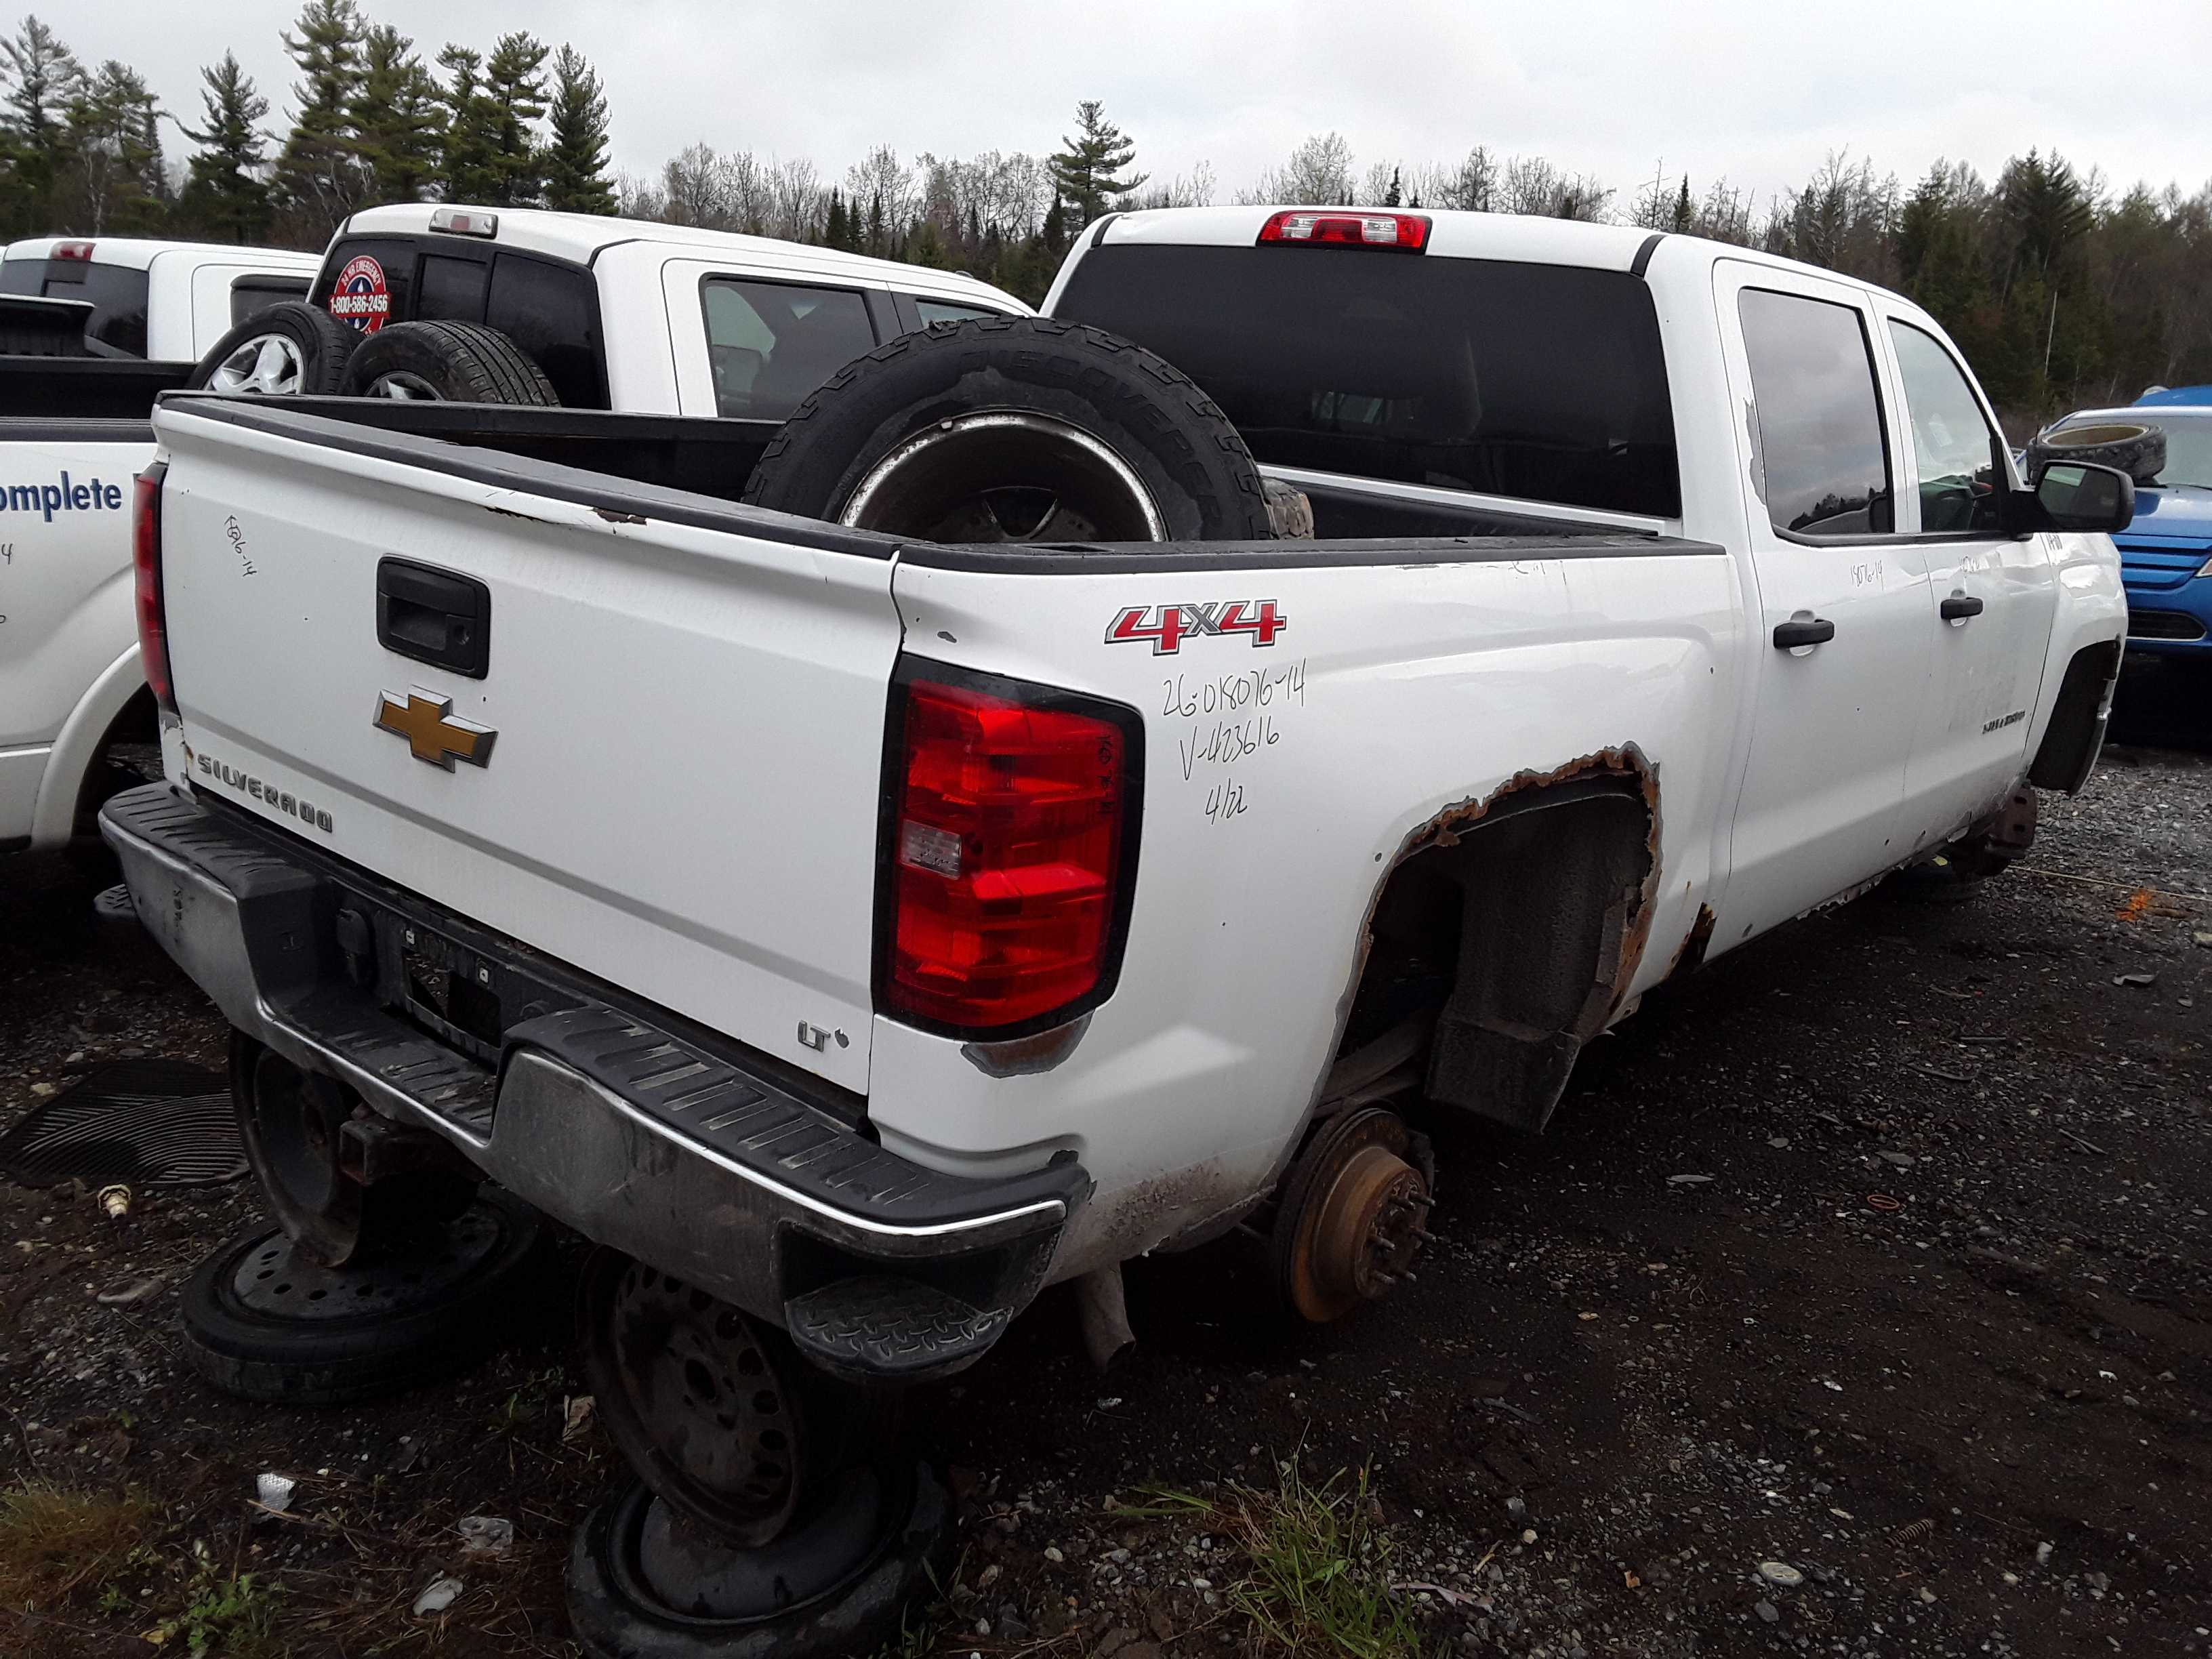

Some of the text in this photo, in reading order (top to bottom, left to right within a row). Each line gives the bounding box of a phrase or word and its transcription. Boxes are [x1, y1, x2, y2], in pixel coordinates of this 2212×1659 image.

[356, 260, 382, 285] EMERGENCY
[330, 294, 388, 313] 1-800-586-2456
[197, 753, 333, 834] SILVERADO
[798, 1020, 831, 1052] LT
